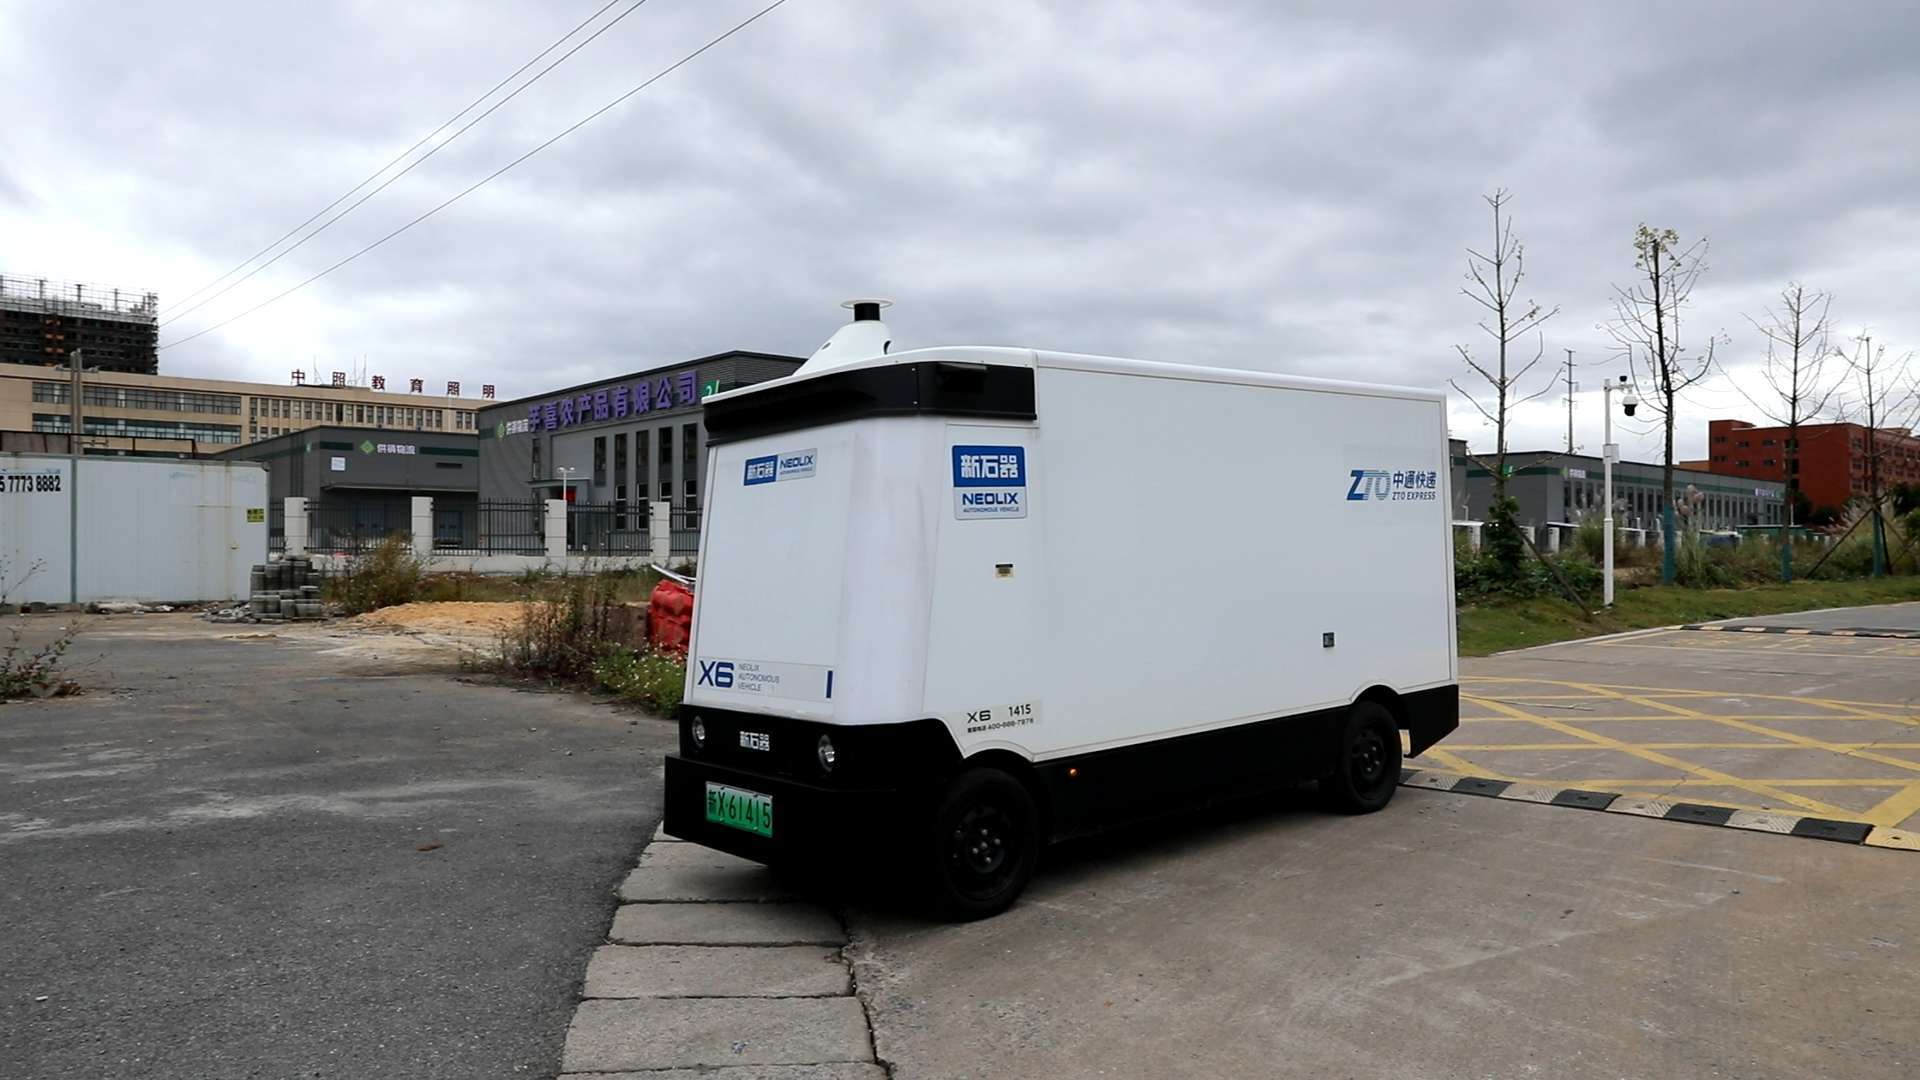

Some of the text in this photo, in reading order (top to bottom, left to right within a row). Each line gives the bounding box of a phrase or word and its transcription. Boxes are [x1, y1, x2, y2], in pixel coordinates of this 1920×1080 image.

[291, 369, 496, 399] 中照教育照明
[780, 455, 814, 469] NEOLIX
[961, 455, 1018, 478] 新石器
[8, 475, 33, 492] 7773
[36, 475, 61, 492] 8882
[1346, 470, 1391, 501] ZTO
[1393, 471, 1437, 489] 中通快递
[962, 493, 1018, 505] NEOLIX
[1392, 491, 1436, 501] ZTO EXPRESS
[698, 660, 734, 688] X6
[967, 704, 1032, 723] X6 1415
[740, 731, 770, 751] 新石器
